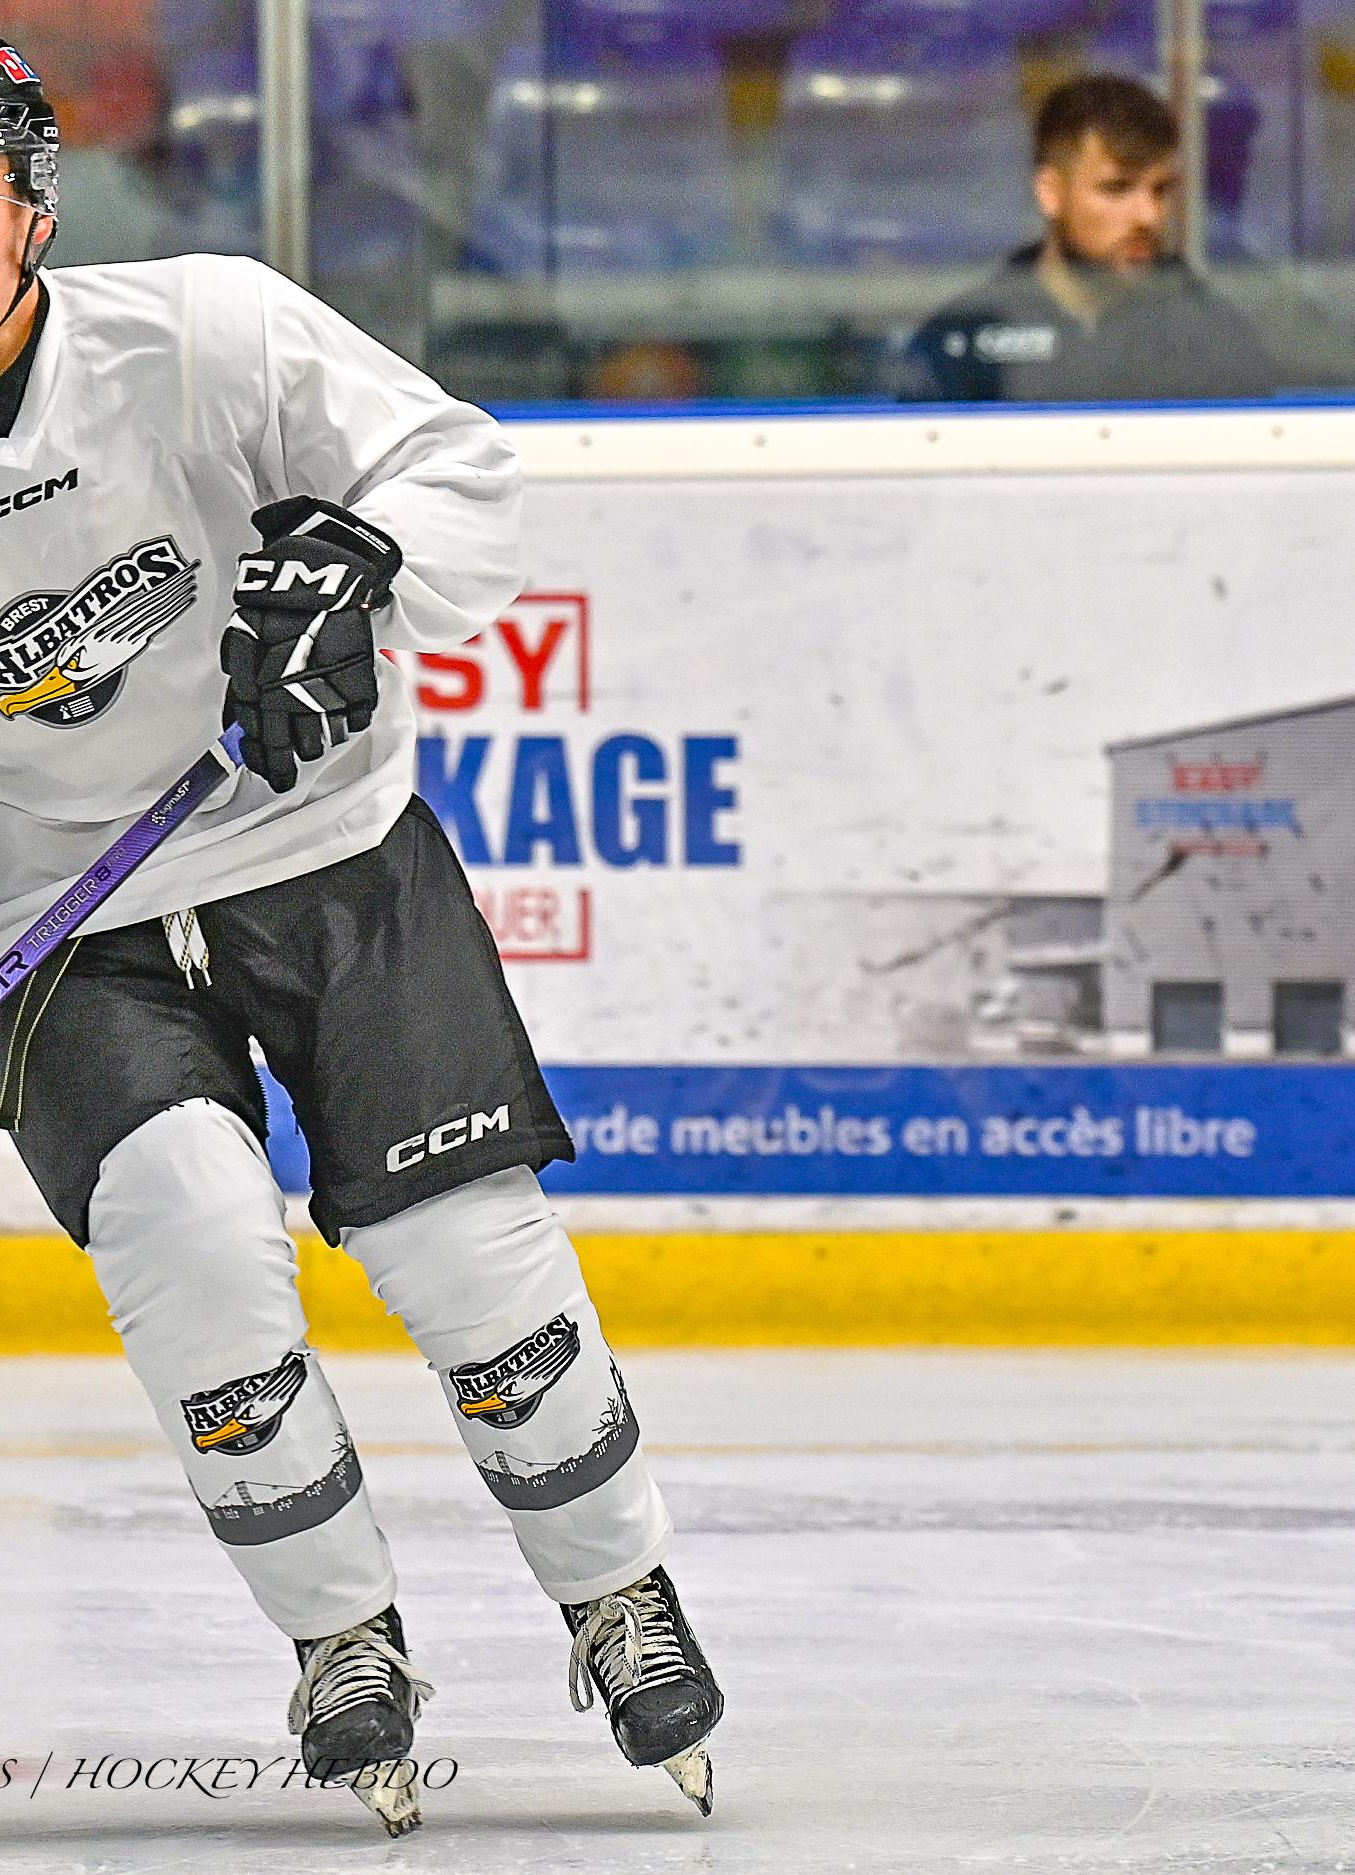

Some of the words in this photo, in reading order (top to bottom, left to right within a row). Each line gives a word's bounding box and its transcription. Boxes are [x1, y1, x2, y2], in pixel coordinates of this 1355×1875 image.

[0, 597, 49, 632] BREST
[380, 620, 569, 714] SY
[416, 733, 743, 869] KAGE
[26, 878, 98, 949] TRIGGER
[385, 1103, 511, 1173] CCM
[670, 1103, 892, 1156] meubles
[901, 1116, 970, 1157] en
[980, 1105, 1126, 1158] accès
[1135, 1105, 1257, 1158] libre
[455, 1319, 569, 1399] ALBATROS
[188, 1371, 271, 1430] ALBAT
